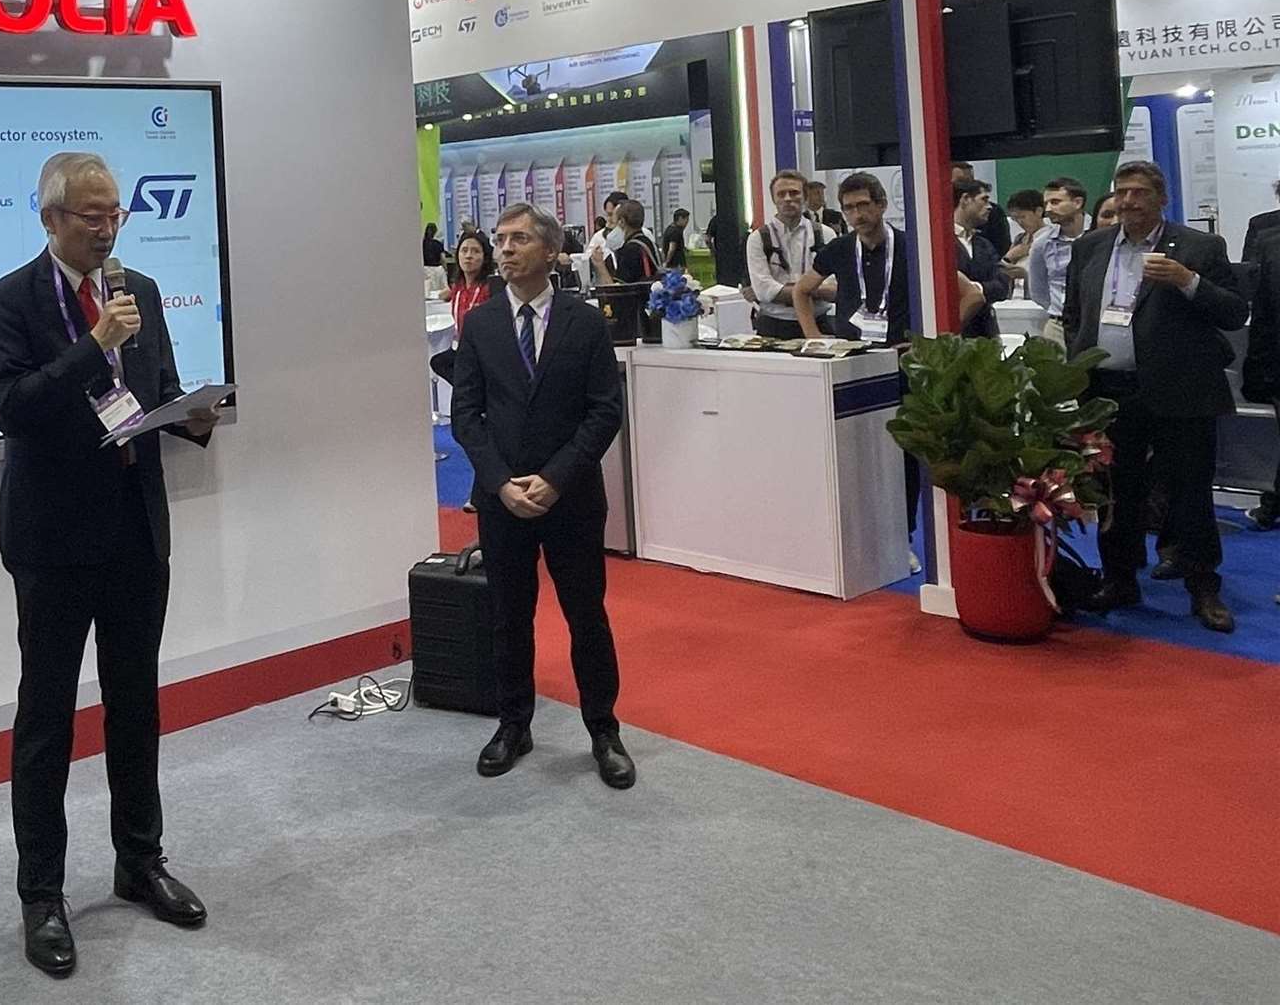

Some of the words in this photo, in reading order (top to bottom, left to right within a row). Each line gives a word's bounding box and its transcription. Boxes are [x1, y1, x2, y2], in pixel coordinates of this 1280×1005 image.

[422, 24, 442, 38] ECM
[1127, 48, 1173, 62] YUAN
[31, 129, 103, 145] ecosystem.
[162, 295, 203, 309] EOLIA
